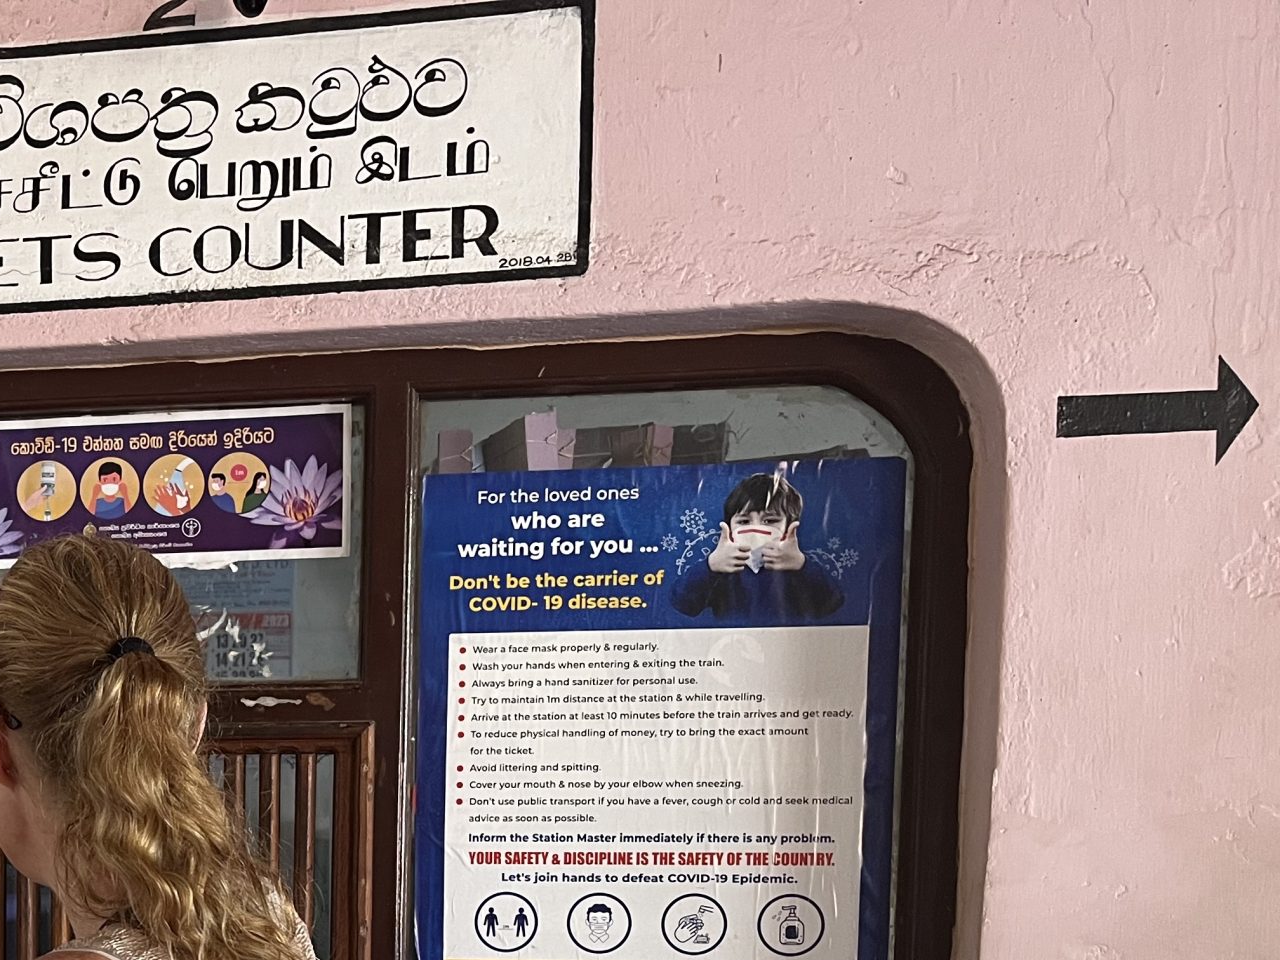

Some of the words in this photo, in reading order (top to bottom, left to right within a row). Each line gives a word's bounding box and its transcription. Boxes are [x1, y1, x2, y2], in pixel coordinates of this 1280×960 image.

[169, 145, 332, 212] பெறும்
[355, 126, 490, 184] இடம்
[149, 204, 499, 276] COUNTER
[223, 428, 275, 451] ඉදිරියට
[478, 490, 505, 504] For
[509, 488, 539, 503] the
[544, 486, 591, 502] loved
[596, 488, 639, 500] ones
[510, 511, 561, 529] who
[567, 513, 605, 527] are
[457, 537, 544, 560] waiting
[550, 536, 584, 555] for
[589, 538, 633, 558] you
[449, 574, 500, 590] Don't
[506, 573, 530, 588] be
[535, 572, 568, 588] the
[573, 569, 638, 587] carrier
[643, 569, 664, 585] of
[468, 596, 538, 612] COVID-
[543, 594, 562, 609] 19
[568, 592, 647, 609] disease.
[472, 645, 497, 653] Wear
[508, 644, 528, 653] face
[531, 644, 557, 652] mask
[560, 643, 601, 653] properly
[603, 643, 610, 651] &
[613, 642, 658, 652] regularly.
[472, 662, 499, 670] Wash
[501, 663, 523, 672] your
[525, 661, 555, 669] hands
[557, 661, 585, 669] when
[587, 659, 629, 670] entering
[632, 659, 639, 668] &
[642, 658, 676, 669] exiting
[678, 658, 695, 667] the
[698, 657, 724, 667] train.
[471, 679, 505, 689] Always
[507, 678, 533, 688] bring
[544, 677, 569, 686] hand
[571, 677, 613, 686] sanitizer
[616, 676, 629, 685] for
[632, 676, 675, 687] personal
[471, 696, 486, 706] Try
[488, 696, 498, 704] to
[501, 695, 544, 704] maintain
[546, 695, 560, 703] 1m
[562, 694, 604, 703] distance
[619, 694, 636, 702] the
[638, 693, 673, 702] station
[675, 693, 682, 701] &
[684, 693, 712, 701] while
[714, 692, 765, 703] travelling.
[469, 763, 496, 772] Avoid
[499, 763, 537, 773] littering
[540, 762, 558, 771] and
[561, 762, 601, 773] spitting.
[468, 832, 506, 842] Inform
[509, 832, 529, 842] the
[532, 832, 573, 842] Station
[576, 833, 616, 842] Master
[619, 832, 693, 845] immediately
[696, 832, 705, 842] if
[707, 833, 739, 843] there
[742, 832, 752, 842] is
[755, 835, 777, 845] any
[780, 833, 835, 845] problem.
[468, 851, 501, 864] YOUR
[504, 851, 549, 865] SAFETY
[551, 852, 561, 865] &
[563, 851, 633, 865] DISCIPLINE
[636, 851, 648, 865] IS
[651, 851, 675, 865] THE
[677, 852, 723, 865] SAFETY
[726, 852, 742, 866] OF
[745, 852, 769, 865] THE
[773, 852, 835, 866] COUNTRY.
[501, 872, 531, 882] Let's
[532, 871, 558, 884] join
[562, 872, 601, 882] hands
[604, 873, 618, 882] to
[621, 873, 664, 882] defeat
[667, 873, 728, 883] COVID-19
[731, 872, 797, 885] Epidemic.
